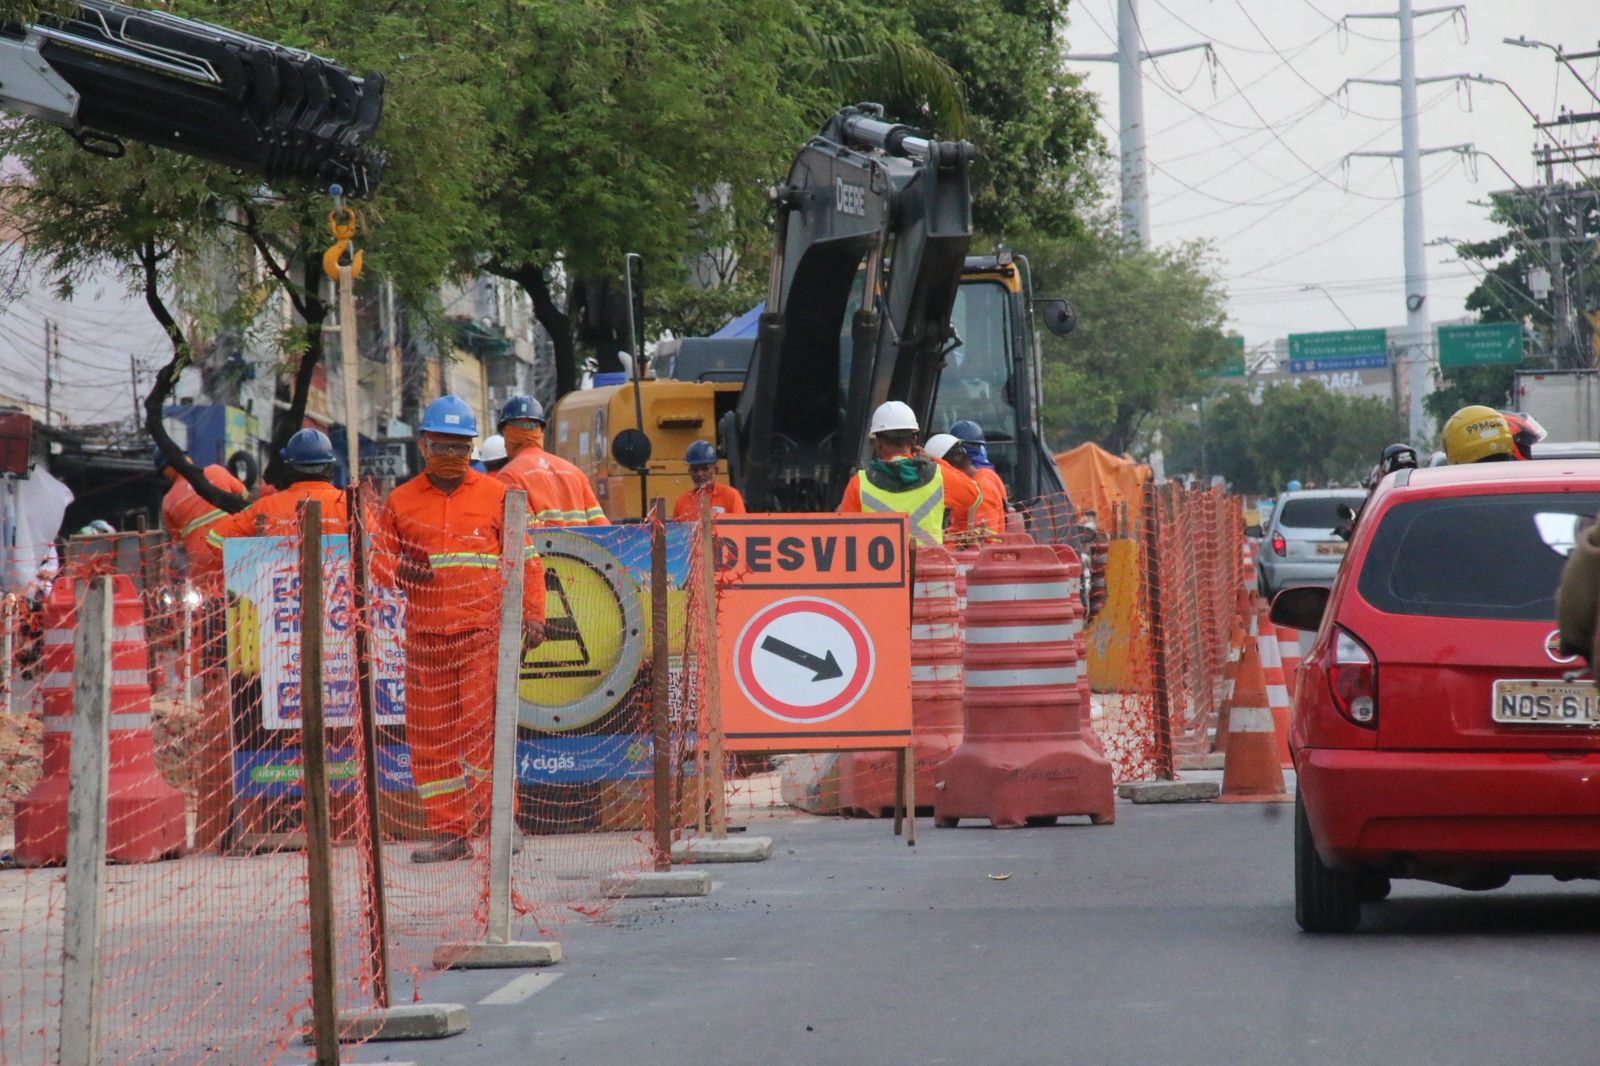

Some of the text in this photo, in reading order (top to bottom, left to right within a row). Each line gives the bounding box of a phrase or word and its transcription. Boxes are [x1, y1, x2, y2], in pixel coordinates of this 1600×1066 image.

[836, 176, 865, 216] DEERE
[713, 536, 895, 572] DESVIO
[533, 753, 575, 773] cigás
